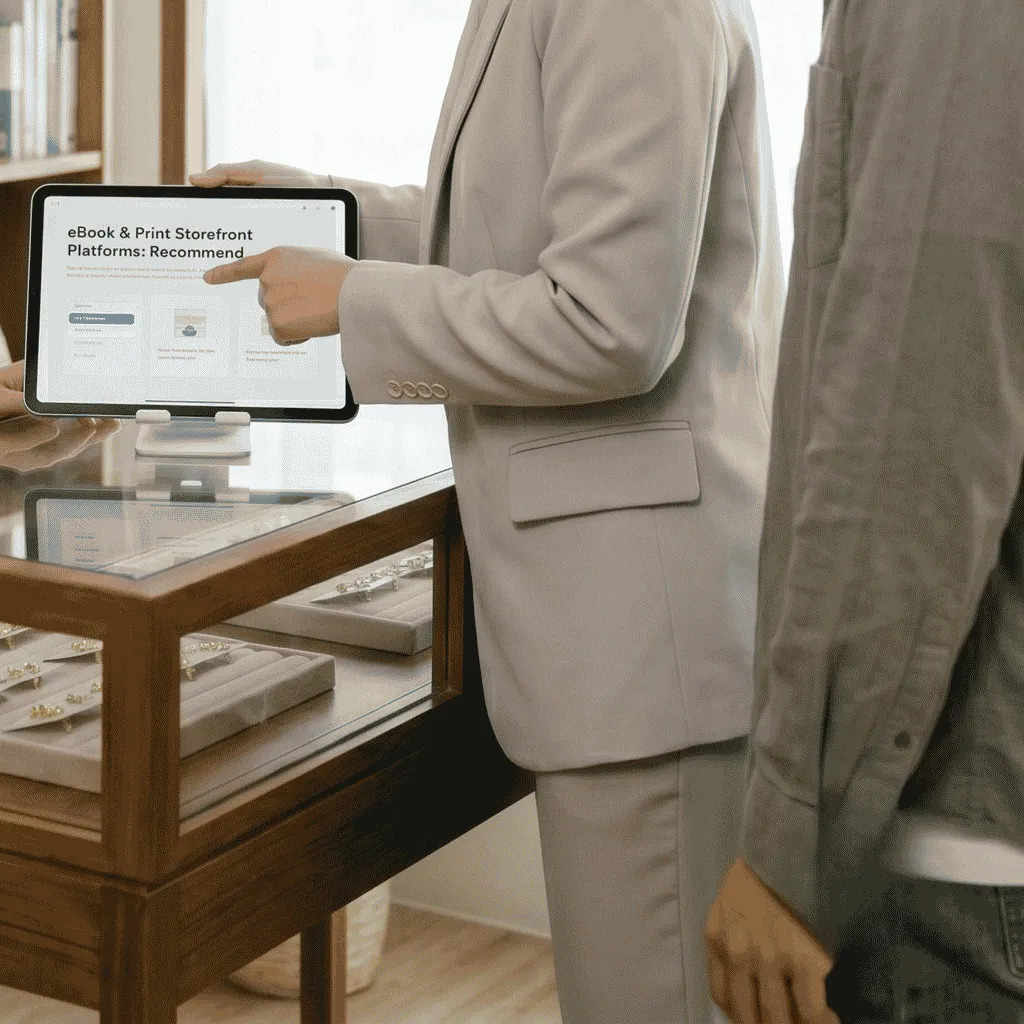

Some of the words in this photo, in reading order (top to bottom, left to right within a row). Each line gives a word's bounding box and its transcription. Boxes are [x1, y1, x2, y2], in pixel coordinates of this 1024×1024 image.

[67, 225, 115, 239] eBook
[119, 226, 131, 239] &
[135, 226, 171, 240] Print
[175, 227, 253, 241] Storefront
[67, 244, 146, 258] Platforms:
[149, 245, 244, 259] Recommend
